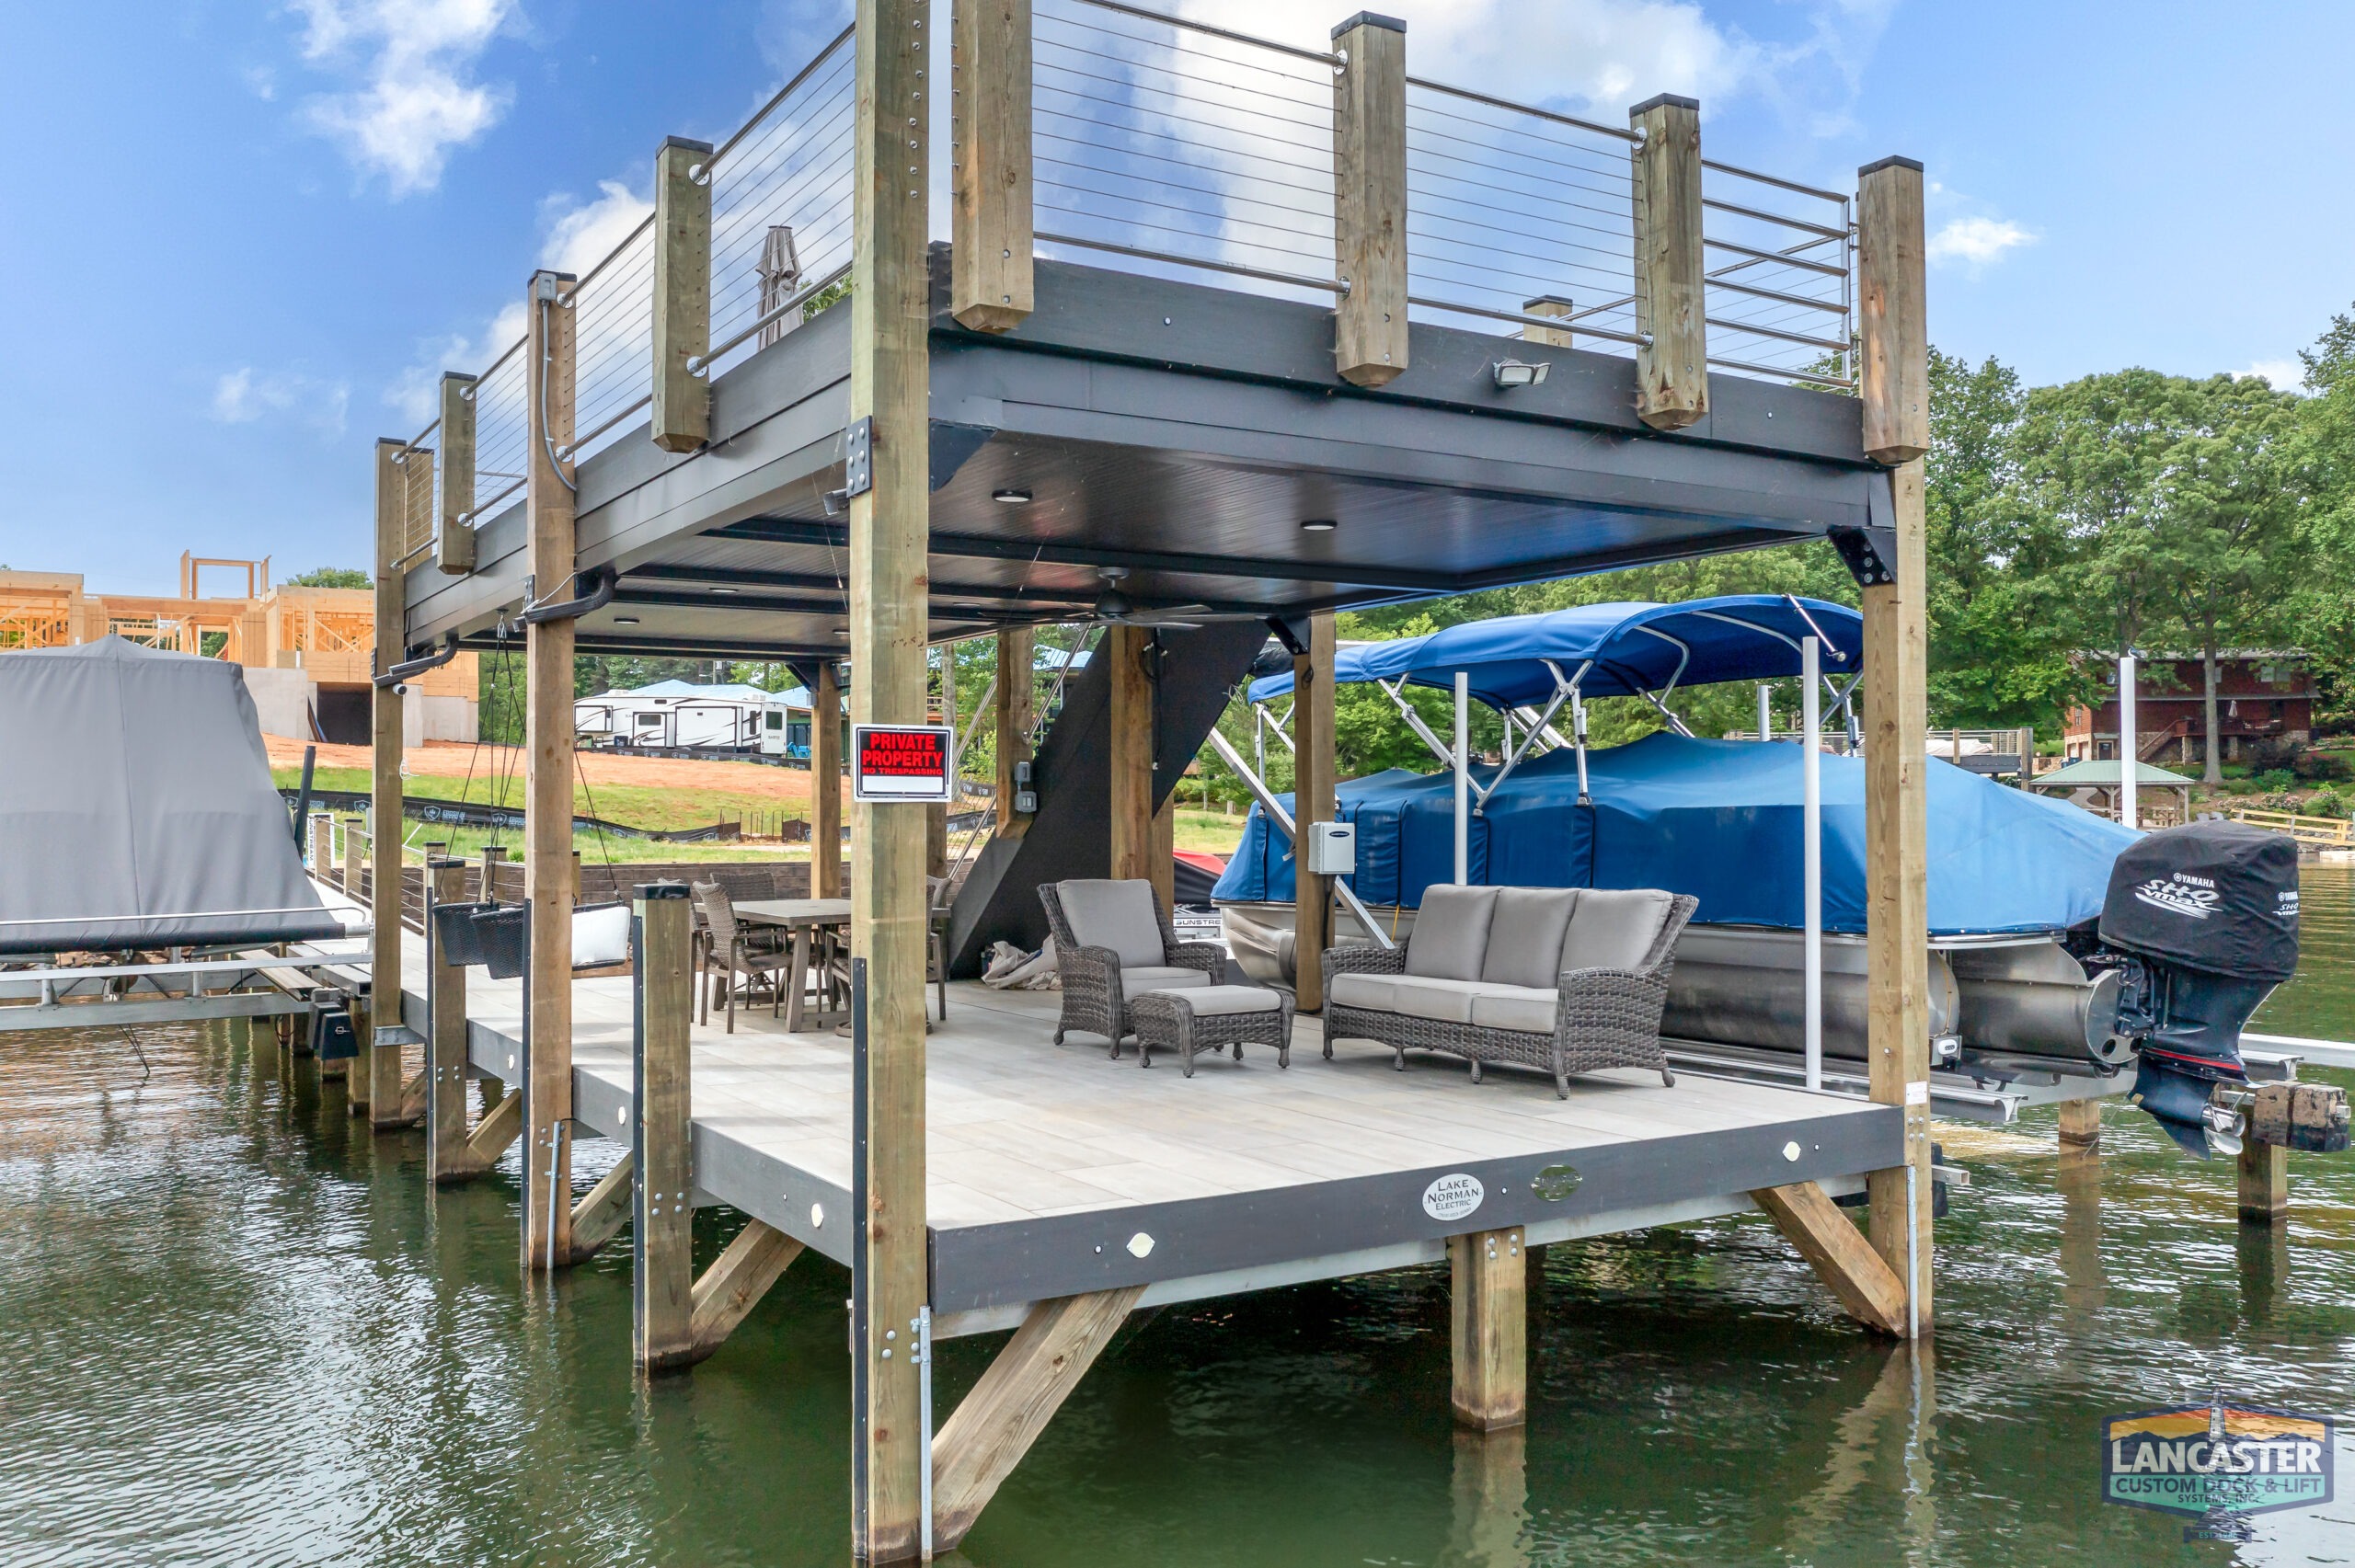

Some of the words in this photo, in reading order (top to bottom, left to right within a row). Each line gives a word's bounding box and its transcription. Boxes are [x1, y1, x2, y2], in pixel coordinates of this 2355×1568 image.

[869, 733, 936, 750] PRIVATE
[862, 750, 943, 767] PROPERTY
[862, 767, 876, 775] NO
[879, 767, 943, 775] TRESPASSING
[2182, 874, 2215, 888] YAMAHA
[2143, 878, 2220, 902] SHO
[2279, 902, 2299, 910] SHO
[1438, 1179, 1470, 1192] LAKE
[1428, 1187, 1479, 1204] NORMAN
[1435, 1198, 1472, 1211] ELECTRIC
